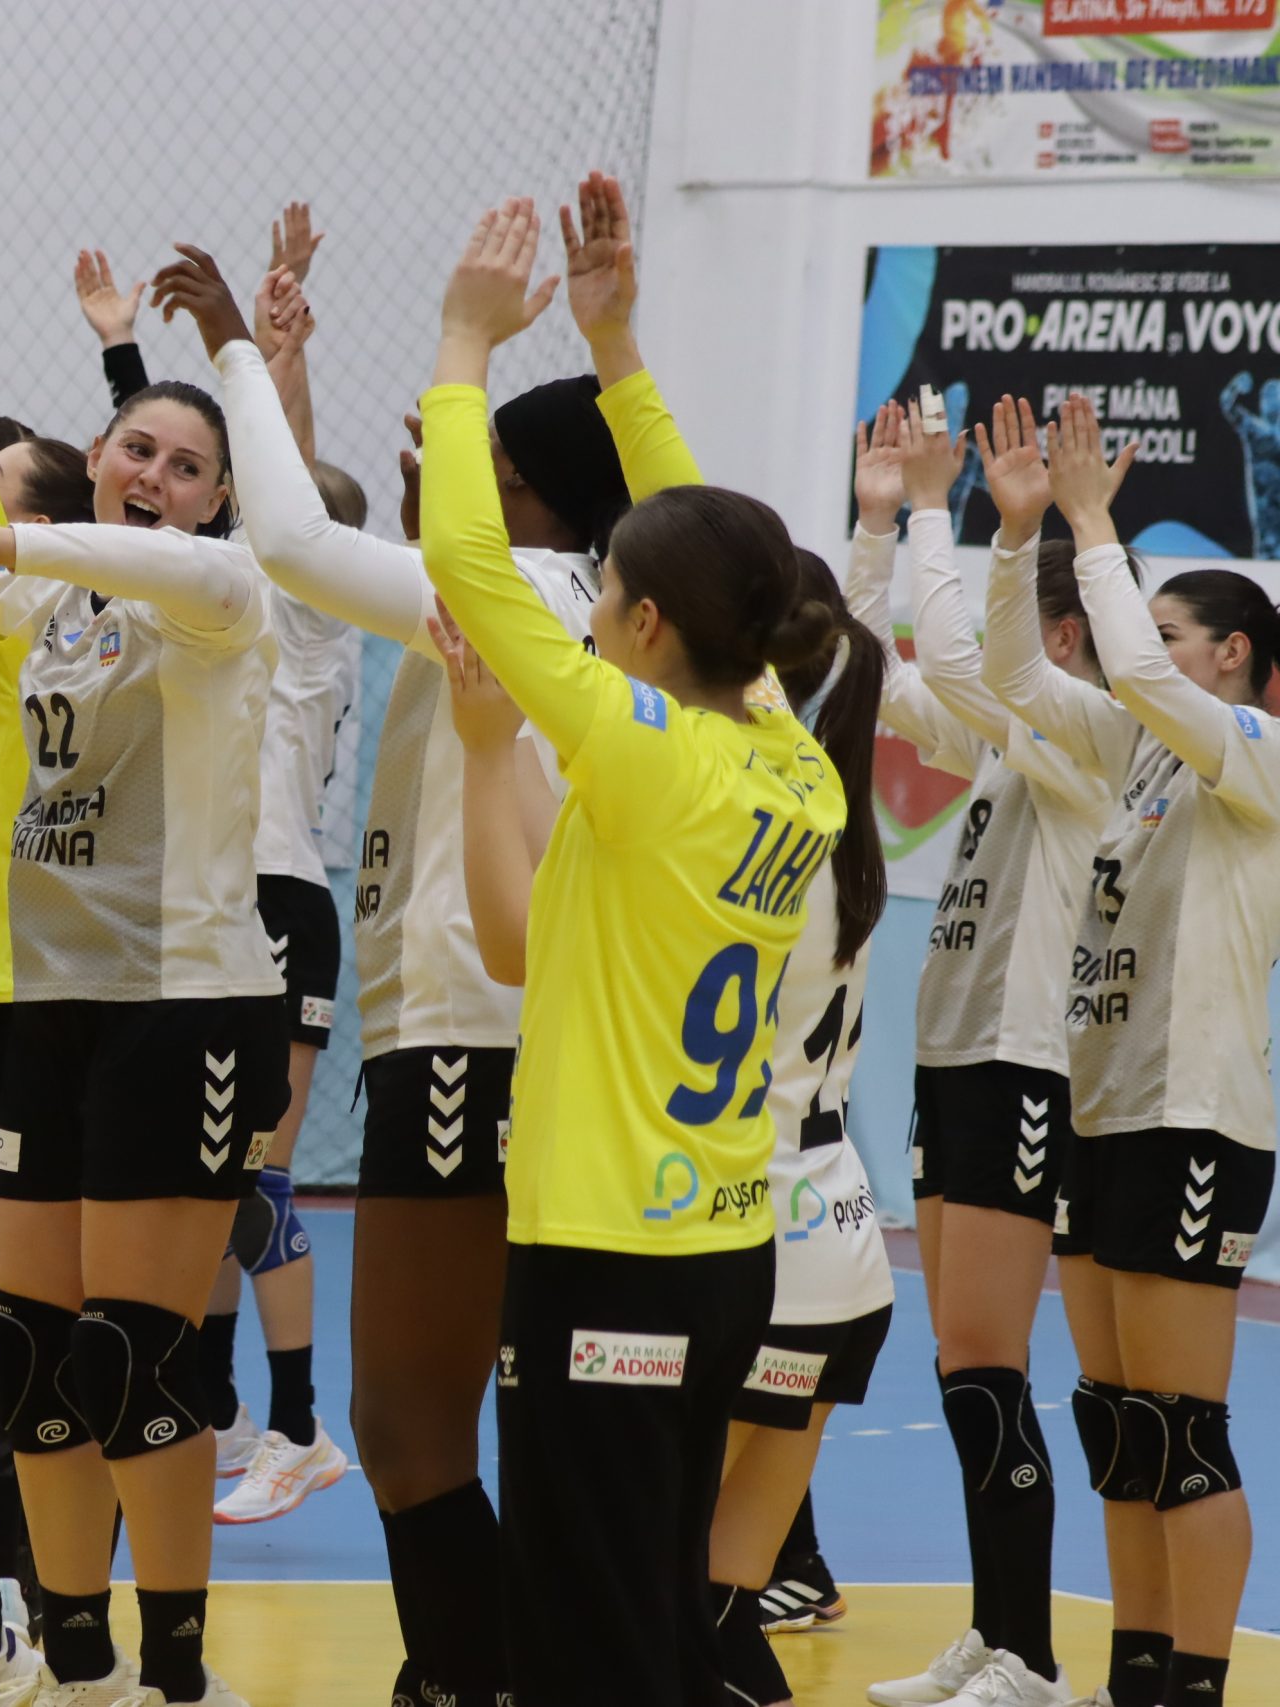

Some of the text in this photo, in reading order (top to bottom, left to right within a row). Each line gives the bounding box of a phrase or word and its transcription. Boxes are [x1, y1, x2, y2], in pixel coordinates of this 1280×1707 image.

[25, 692, 80, 769] 22
[613, 1345, 685, 1358] FARMACIA
[612, 1358, 683, 1378] ADONIS
[760, 1369, 819, 1390] ADONIS
